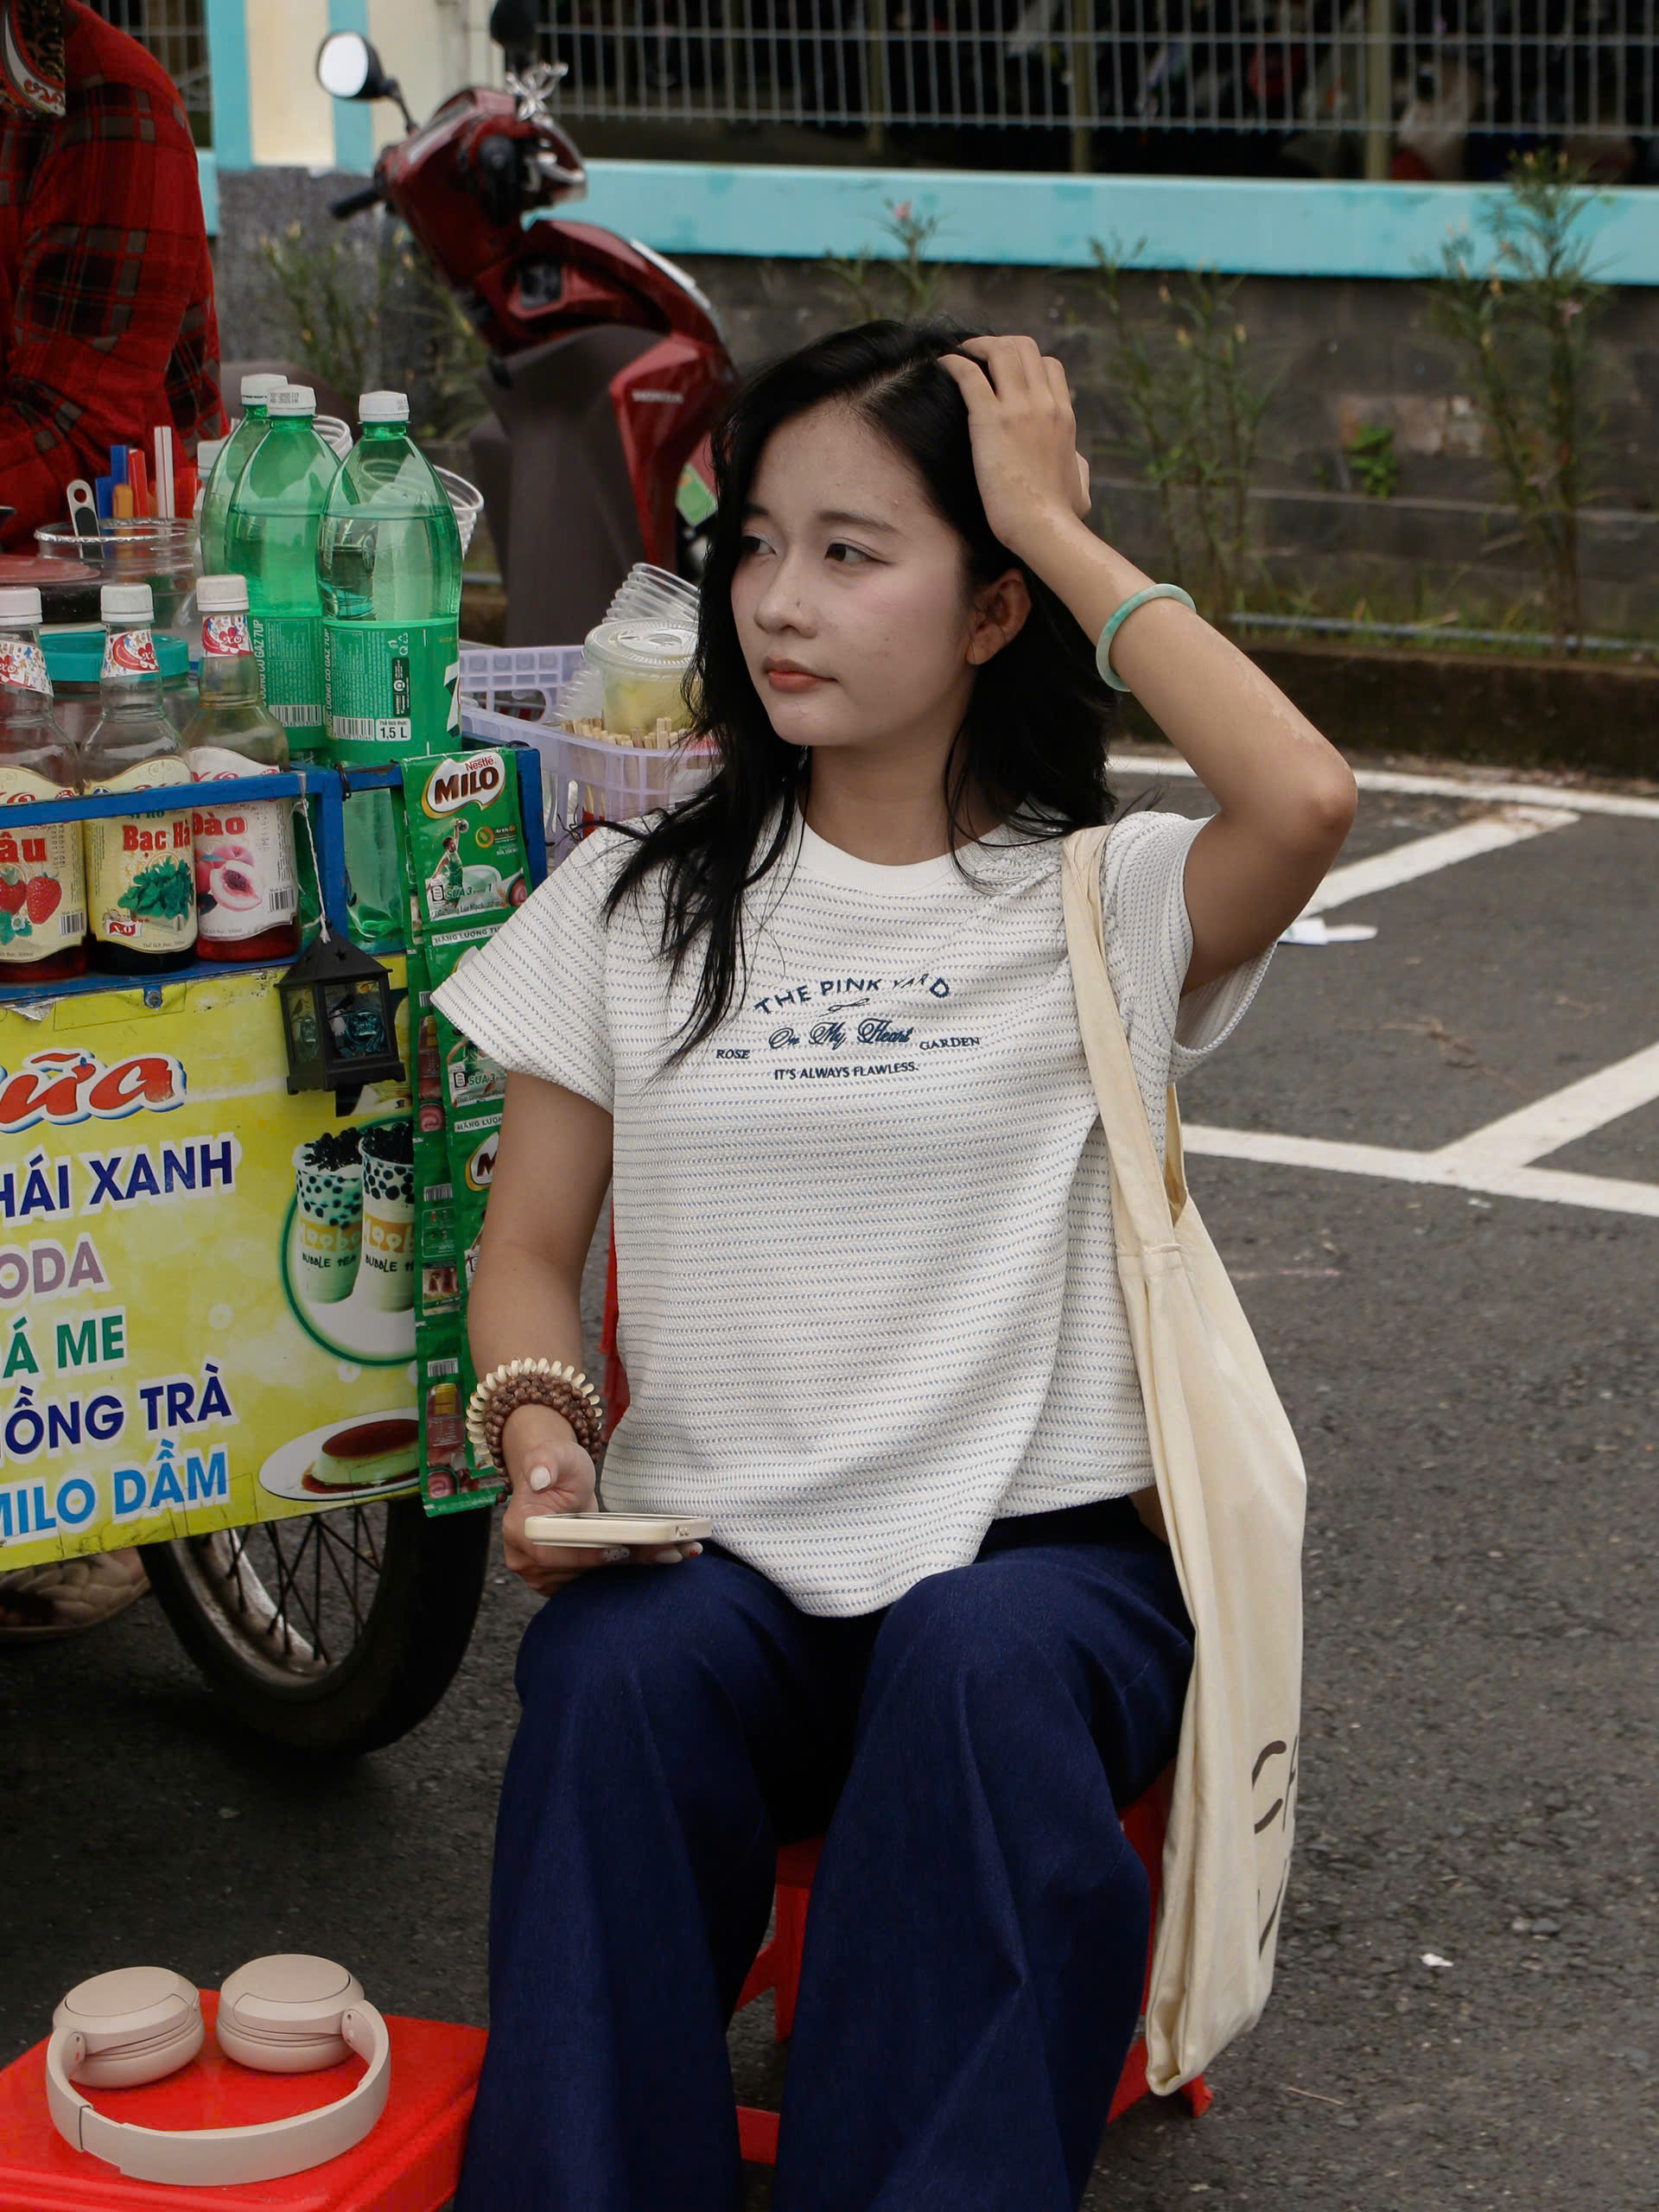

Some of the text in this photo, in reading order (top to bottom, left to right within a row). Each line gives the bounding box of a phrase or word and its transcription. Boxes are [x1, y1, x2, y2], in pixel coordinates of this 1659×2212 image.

[252, 620, 264, 637] 7UP
[380, 726, 396, 740] 1,5
[400, 726, 408, 739] L
[434, 766, 500, 804] MILO
[123, 823, 167, 859] Bạc
[753, 984, 812, 1014] THE
[821, 976, 882, 996] PINK
[768, 1017, 915, 1051] On My Heart
[919, 1036, 982, 1051] GARDEN
[715, 1049, 751, 1059] ROSE
[774, 1068, 796, 1080] IT'S
[799, 1065, 851, 1079] ALWAYS
[0, 1052, 175, 1124] ữa
[89, 1141, 233, 1205] XANH
[0, 1241, 105, 1299] ODA
[3, 1314, 125, 1379] Á ME
[0, 1363, 232, 1456] ỒNG TRÀ
[113, 1439, 227, 1516] DẦM
